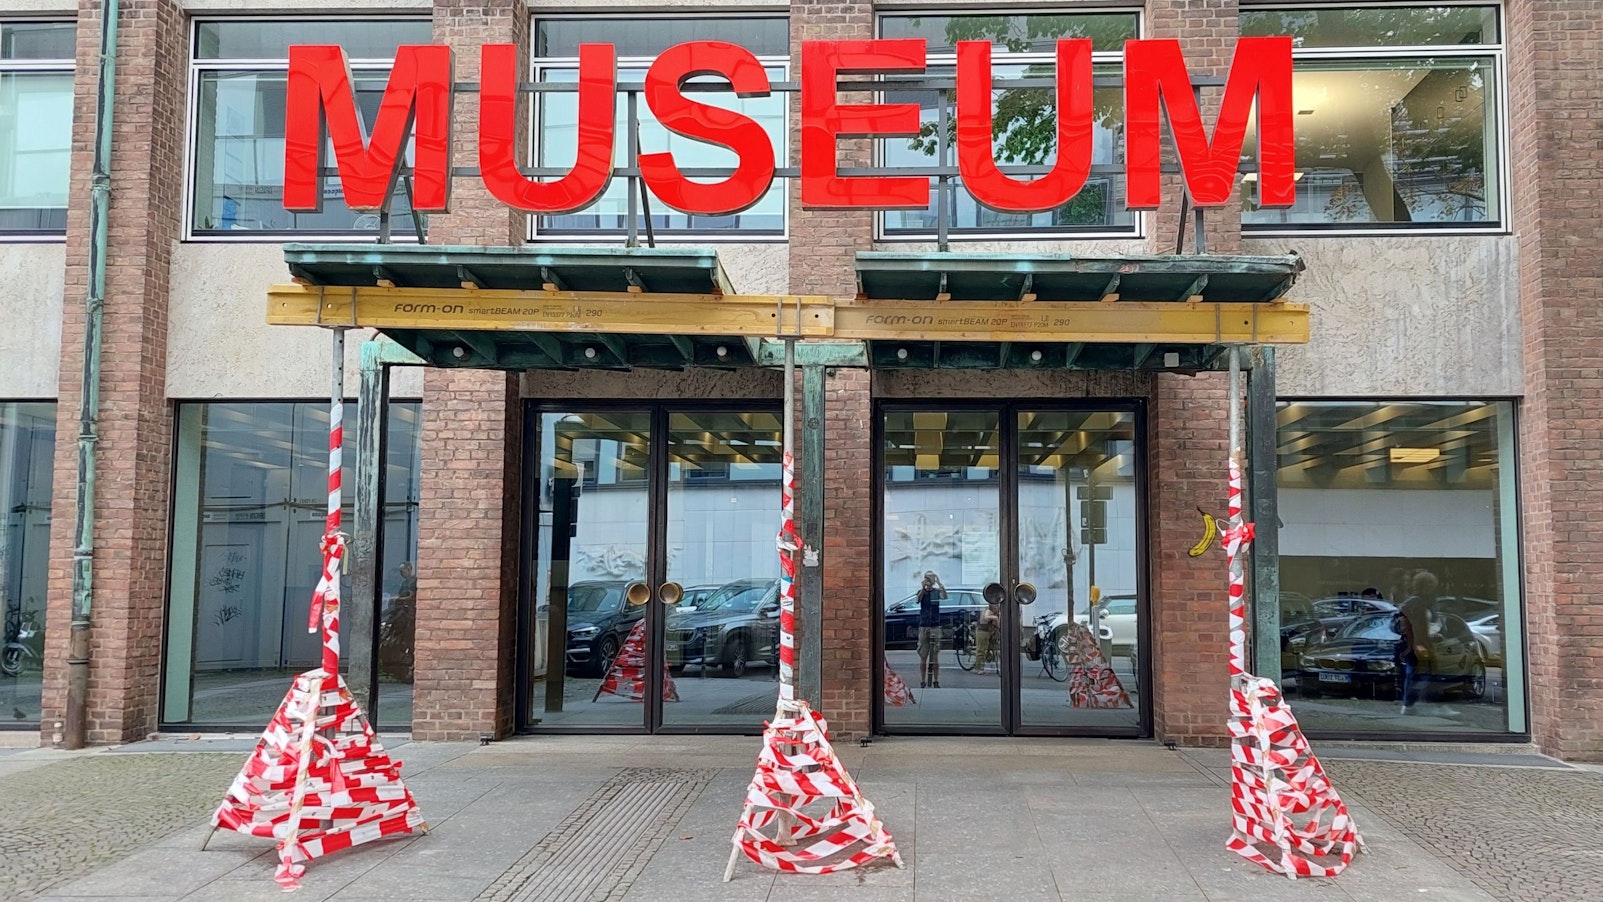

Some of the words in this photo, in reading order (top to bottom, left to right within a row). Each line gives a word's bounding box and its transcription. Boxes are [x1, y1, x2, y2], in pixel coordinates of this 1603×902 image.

[283, 37, 1296, 215] MUSEUM
[468, 307, 521, 315] smartBEAM
[585, 309, 603, 317] 290
[937, 317, 990, 326] smartBEAM
[990, 318, 1008, 326] 20P
